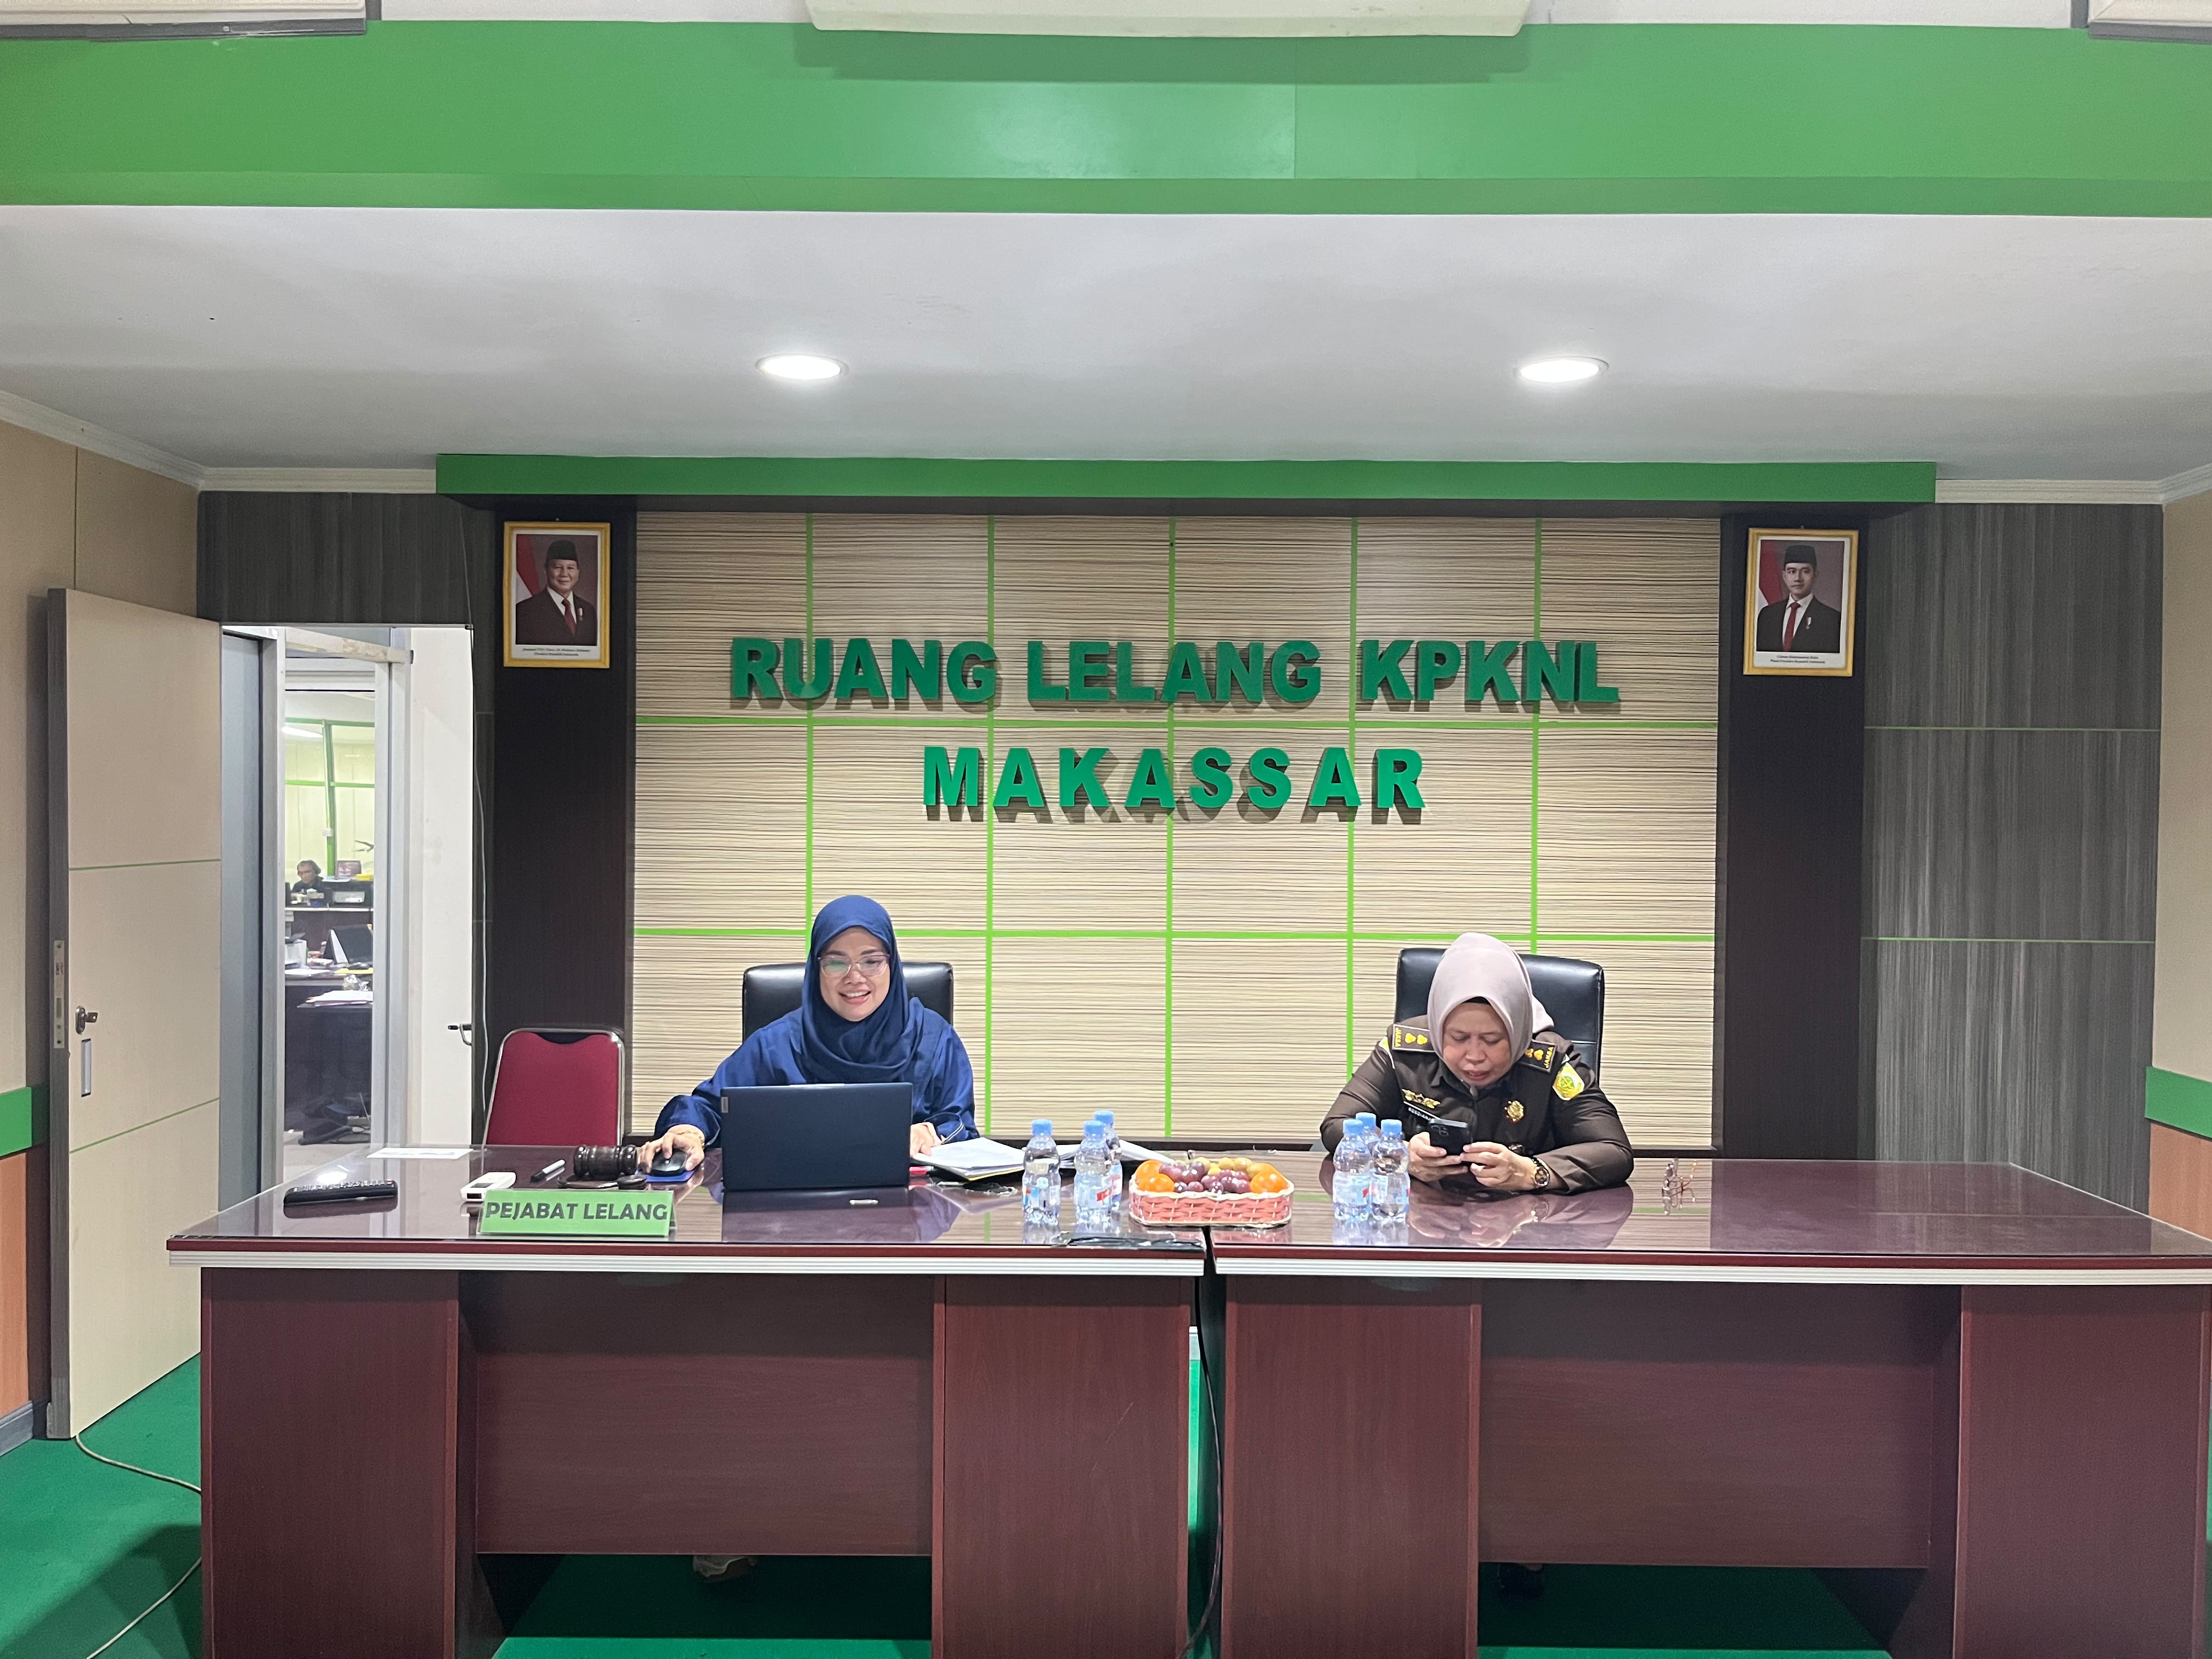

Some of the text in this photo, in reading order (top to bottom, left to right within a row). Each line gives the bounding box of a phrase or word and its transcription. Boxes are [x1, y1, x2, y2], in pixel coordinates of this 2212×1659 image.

[732, 637, 1619, 703] RUANG LELANG KPKNL
[923, 746, 1426, 809] MAKASSAR
[1544, 1047, 1554, 1069] JAKSA
[486, 1201, 668, 1221] PEJABAT LELANG
